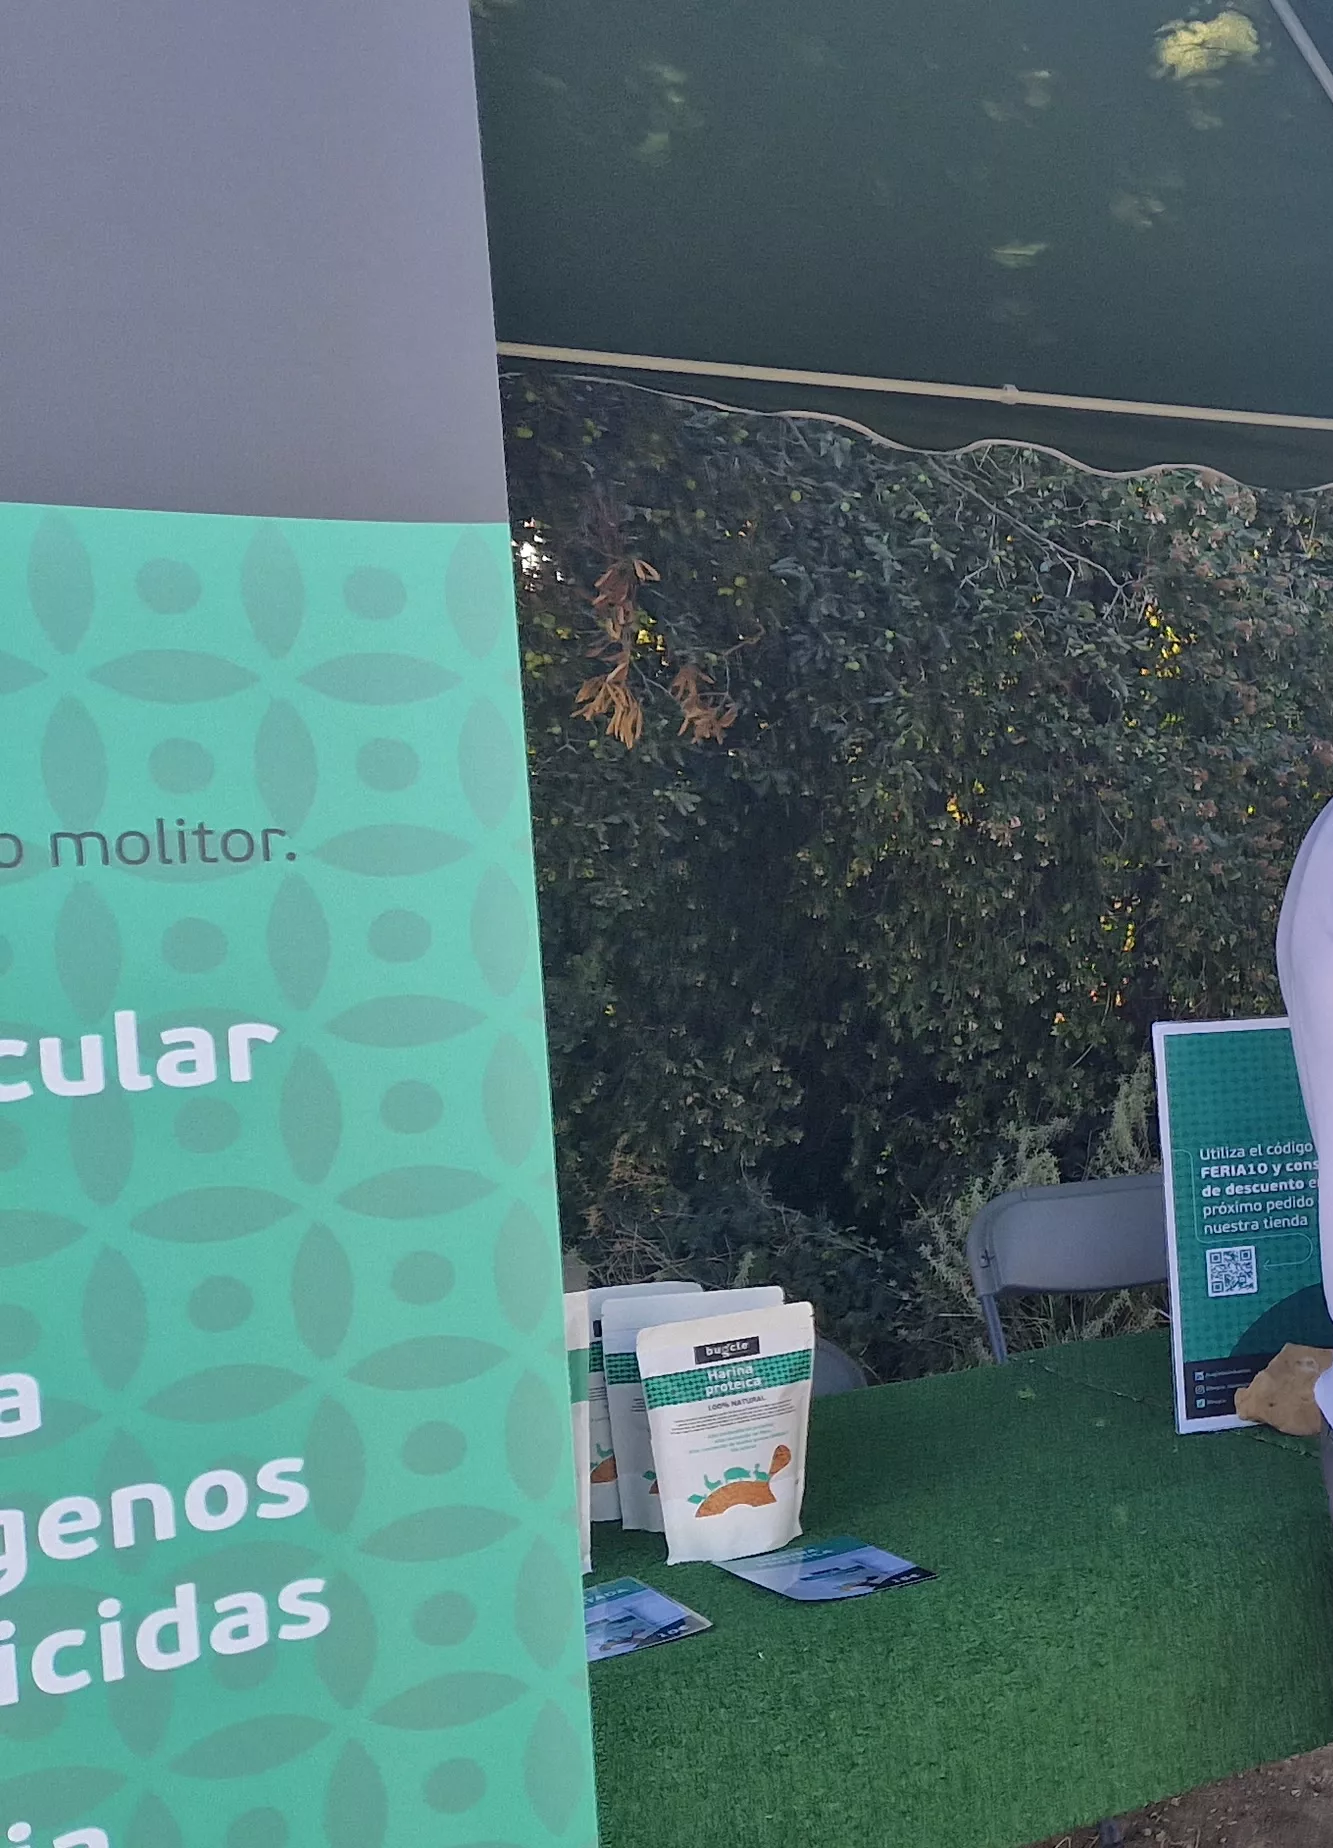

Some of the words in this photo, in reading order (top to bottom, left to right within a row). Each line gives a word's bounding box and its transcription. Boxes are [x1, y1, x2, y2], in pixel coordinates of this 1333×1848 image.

[50, 817, 297, 868] molitor.
[1200, 1145, 1246, 1161] Utiliza
[1249, 1143, 1263, 1157] el
[1266, 1140, 1314, 1157] código
[1200, 1161, 1269, 1179] FERIA10
[1271, 1162, 1282, 1177] y
[1201, 1184, 1221, 1198] de
[1224, 1178, 1305, 1196] descuento
[1202, 1201, 1263, 1219] próximo
[1266, 1195, 1315, 1214] pedido
[1204, 1219, 1260, 1235] nuestra
[1263, 1213, 1309, 1230] tienda
[707, 1364, 754, 1382] Harina
[704, 1377, 763, 1398] proteica
